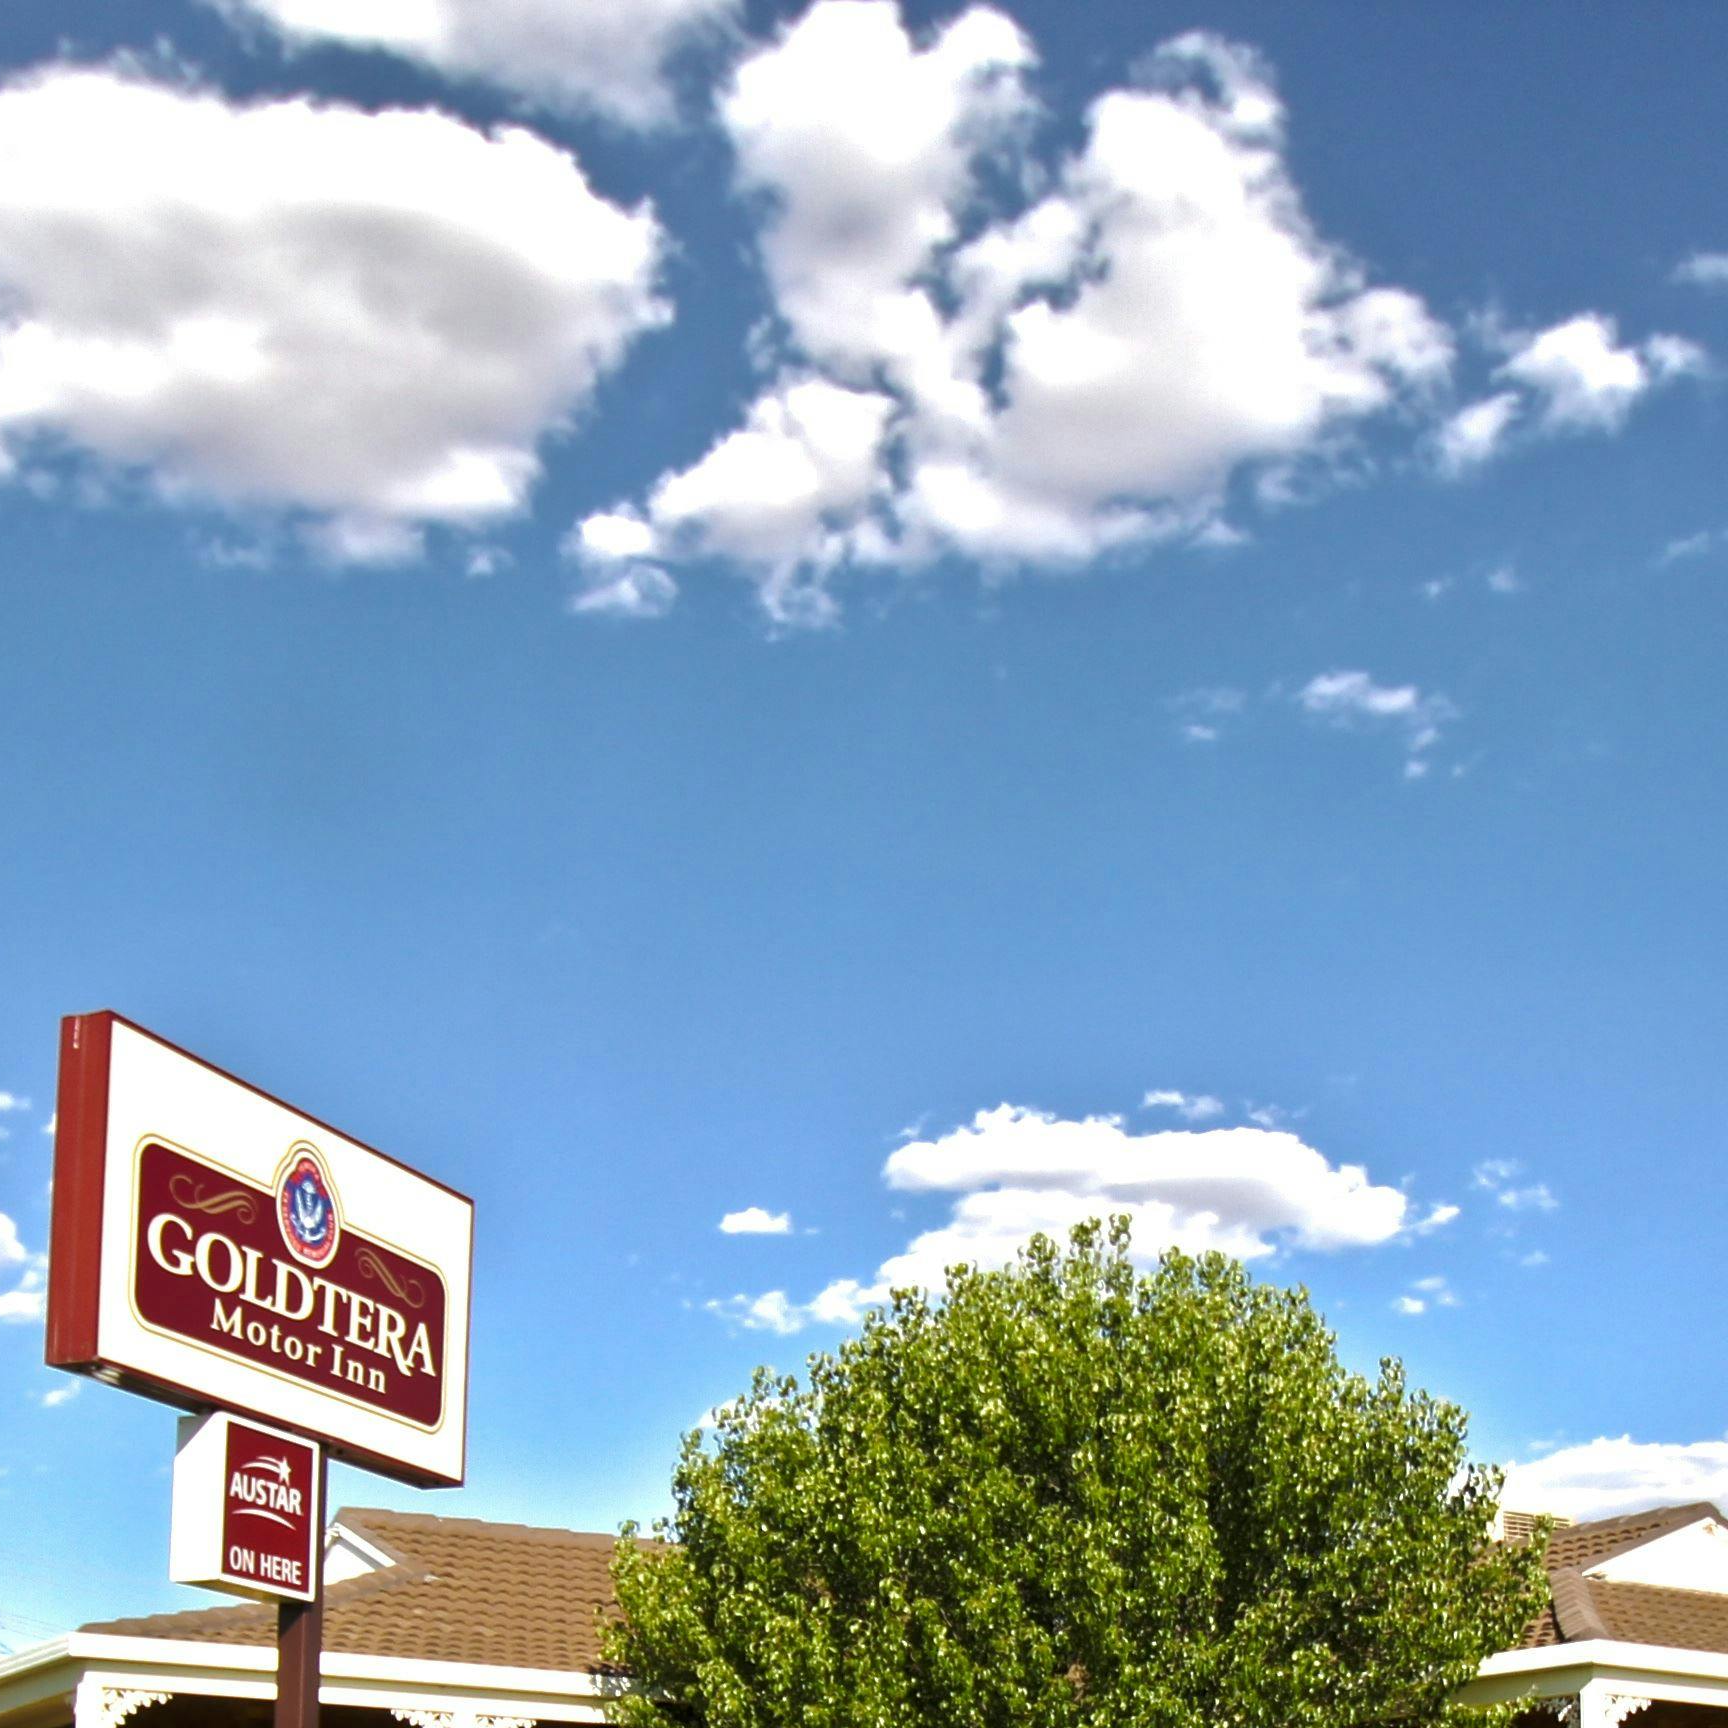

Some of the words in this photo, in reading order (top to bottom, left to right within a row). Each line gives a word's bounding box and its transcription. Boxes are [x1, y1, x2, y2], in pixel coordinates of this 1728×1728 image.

[147, 1212, 436, 1377] GOLDTERA
[210, 1298, 323, 1369] Motor
[330, 1345, 387, 1394] Inn
[229, 1471, 304, 1516] AUSTAR
[229, 1545, 256, 1575] ON
[259, 1552, 302, 1586] HERE
